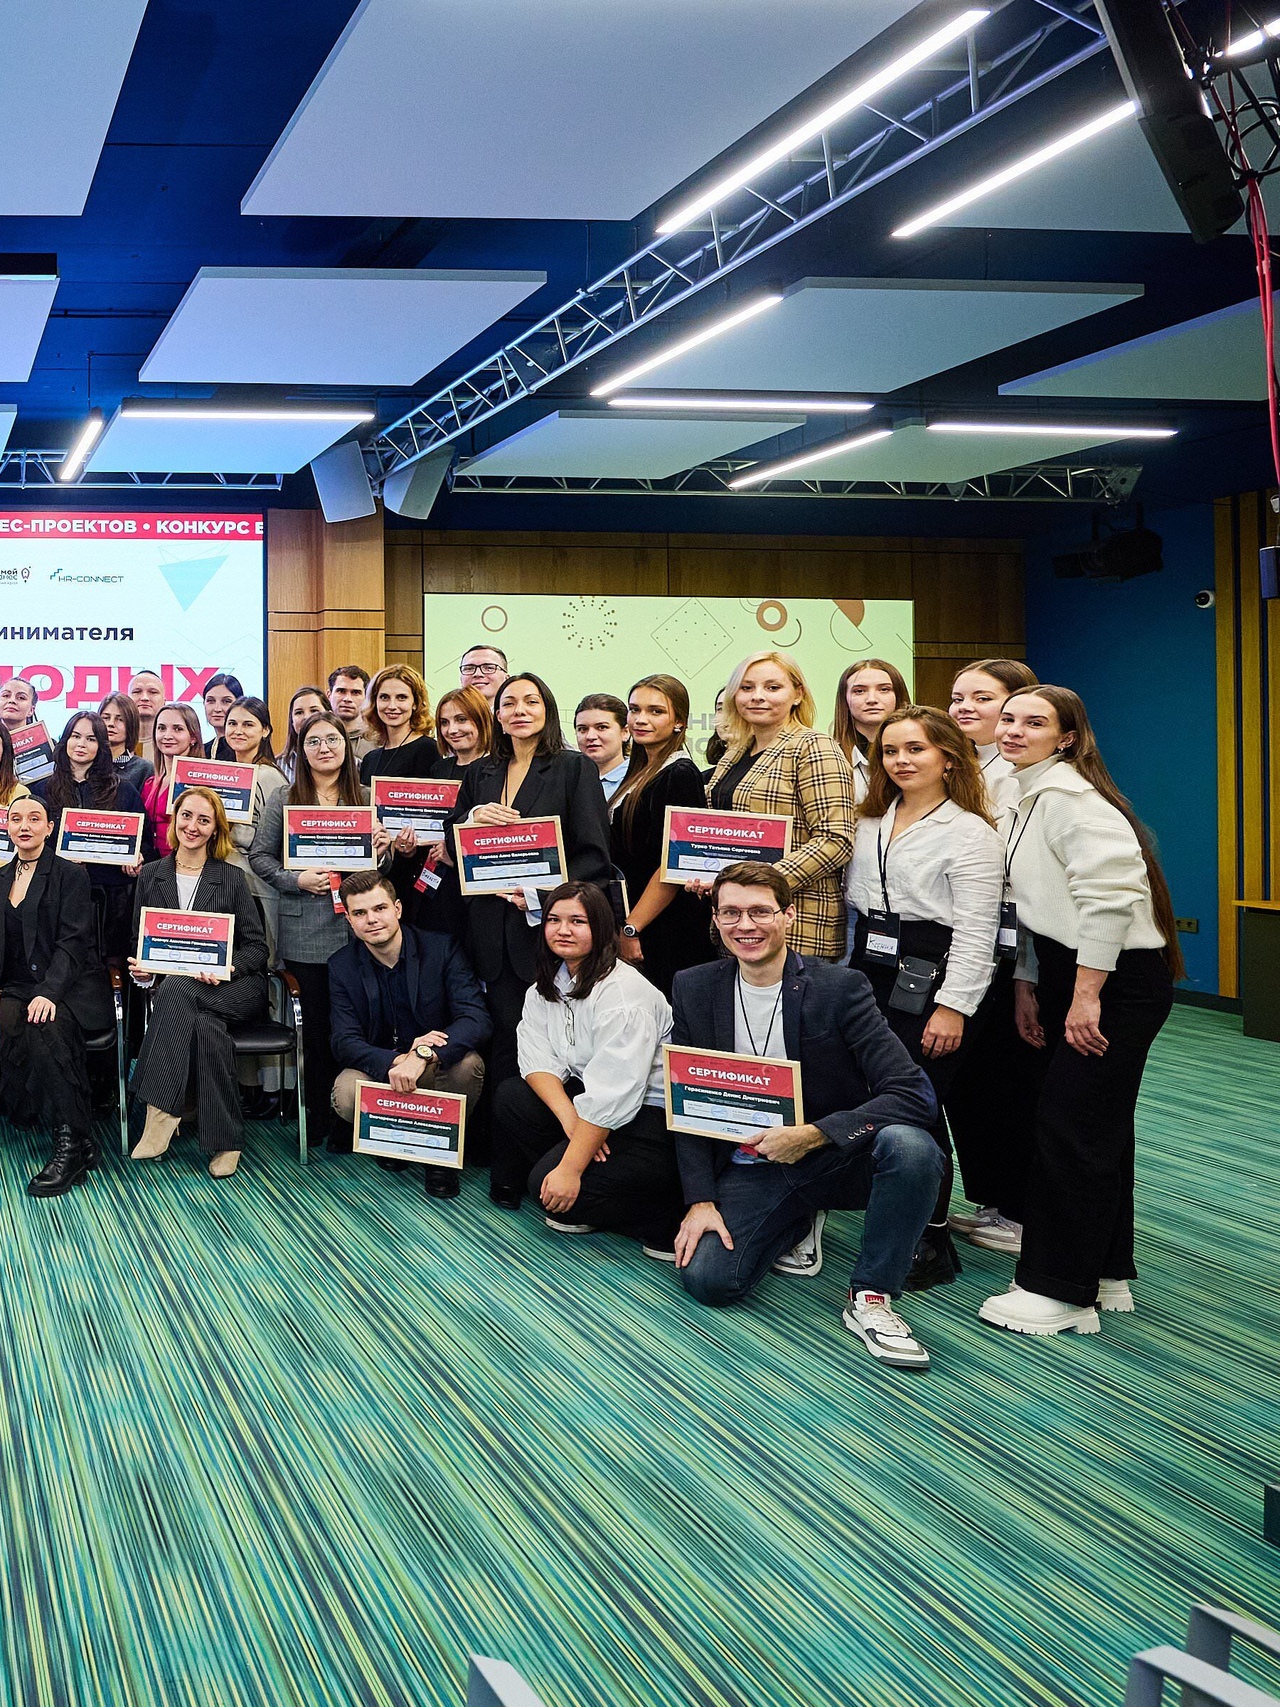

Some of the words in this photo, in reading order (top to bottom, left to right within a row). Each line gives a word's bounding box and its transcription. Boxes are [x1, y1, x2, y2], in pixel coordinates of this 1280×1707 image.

[156, 520, 250, 535] КОНКУРС
[58, 575, 124, 583] HR-CONNECT
[187, 771, 240, 783] СЕРТИФИКАТ
[388, 791, 445, 801] СЕРТИФИКАТ
[76, 820, 127, 830] СЕРТИФИКАТ
[301, 820, 358, 828] СЕРТИФИКАТ
[687, 825, 765, 839] СЕРТИФИКАТ
[474, 834, 538, 846] СЕРТИФИКАТ
[156, 922, 214, 934] СЕРТИФИКАТ
[688, 1066, 771, 1086] СЕРТИФИКАТ
[376, 1098, 443, 1115] СЕРТИФИКАТ
